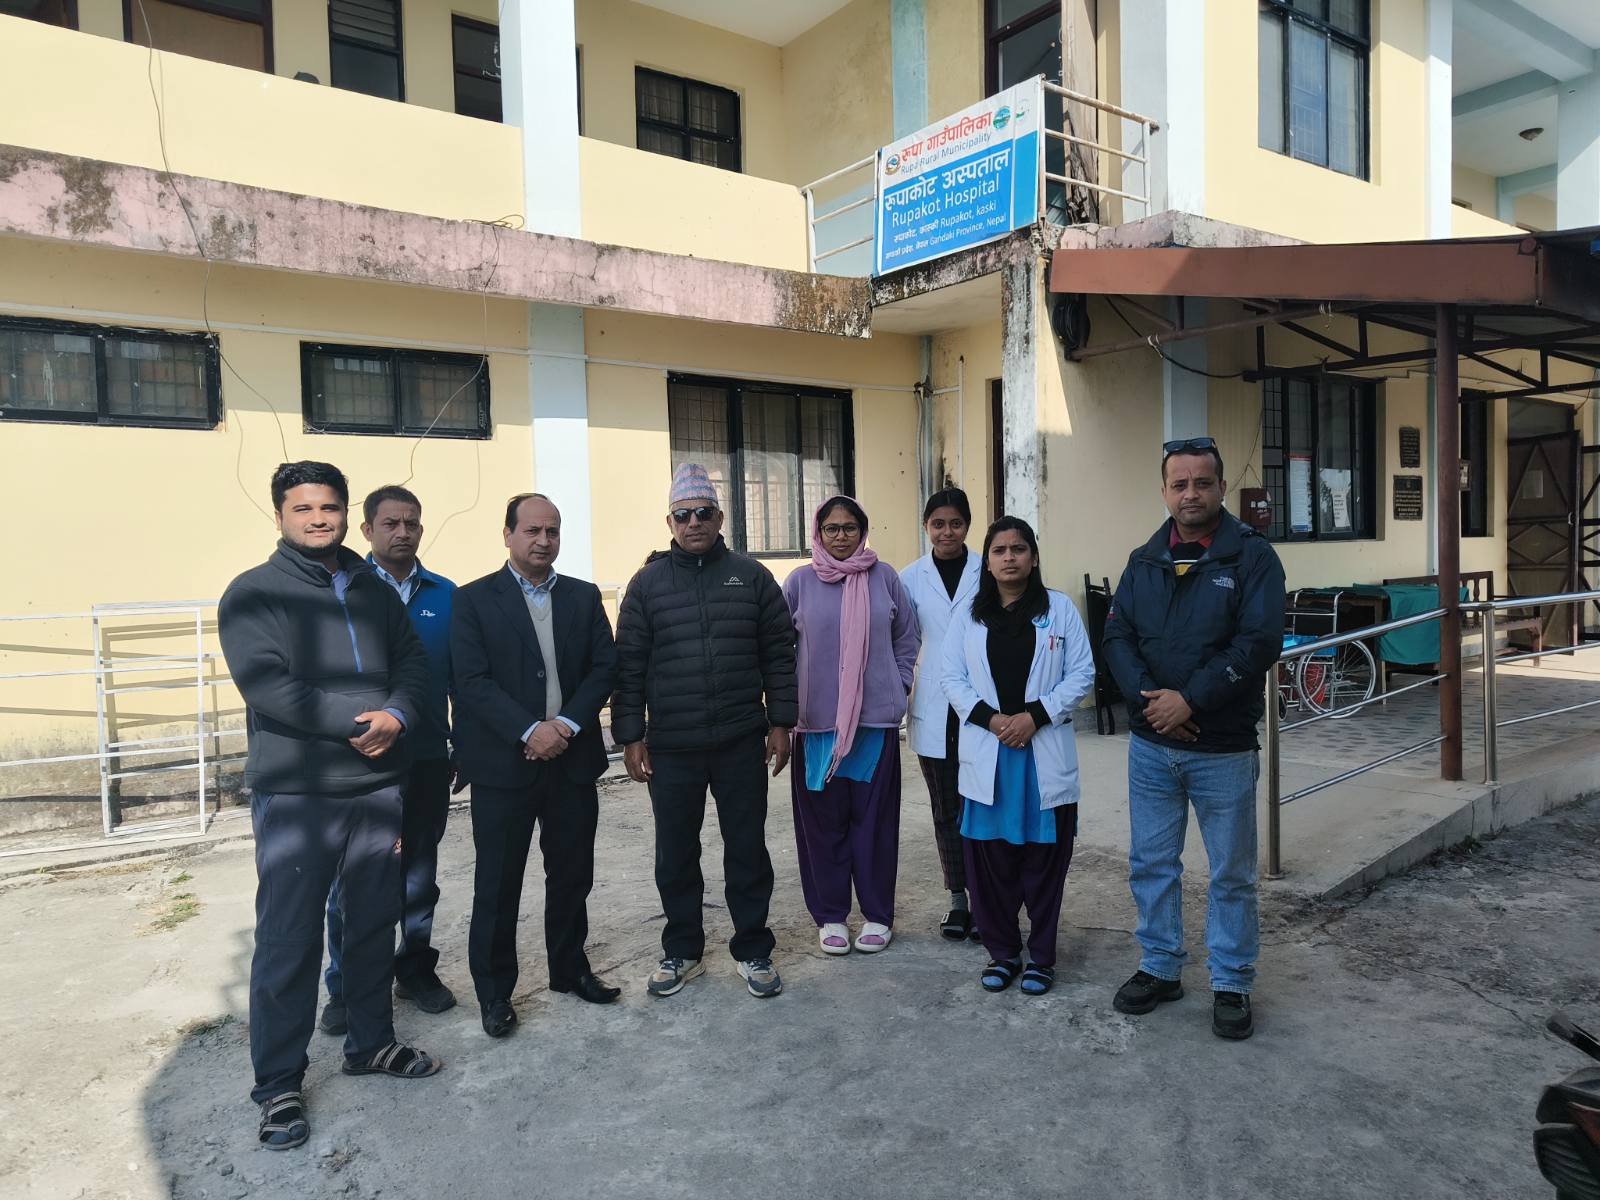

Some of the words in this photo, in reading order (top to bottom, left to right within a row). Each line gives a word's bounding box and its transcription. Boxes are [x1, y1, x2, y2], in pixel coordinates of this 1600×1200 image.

[901, 160, 918, 175] Rupa
[919, 153, 940, 167] Rural
[942, 132, 992, 157] Municipality
[942, 148, 1011, 190] अस्पताल
[892, 197, 941, 227] Rupakot
[945, 172, 1000, 209] Hospital
[940, 209, 974, 228] Rupakot,
[976, 199, 997, 216] kaski
[929, 229, 955, 246] Gandaki
[956, 222, 985, 238] Province,
[986, 211, 1007, 227] Nepal
